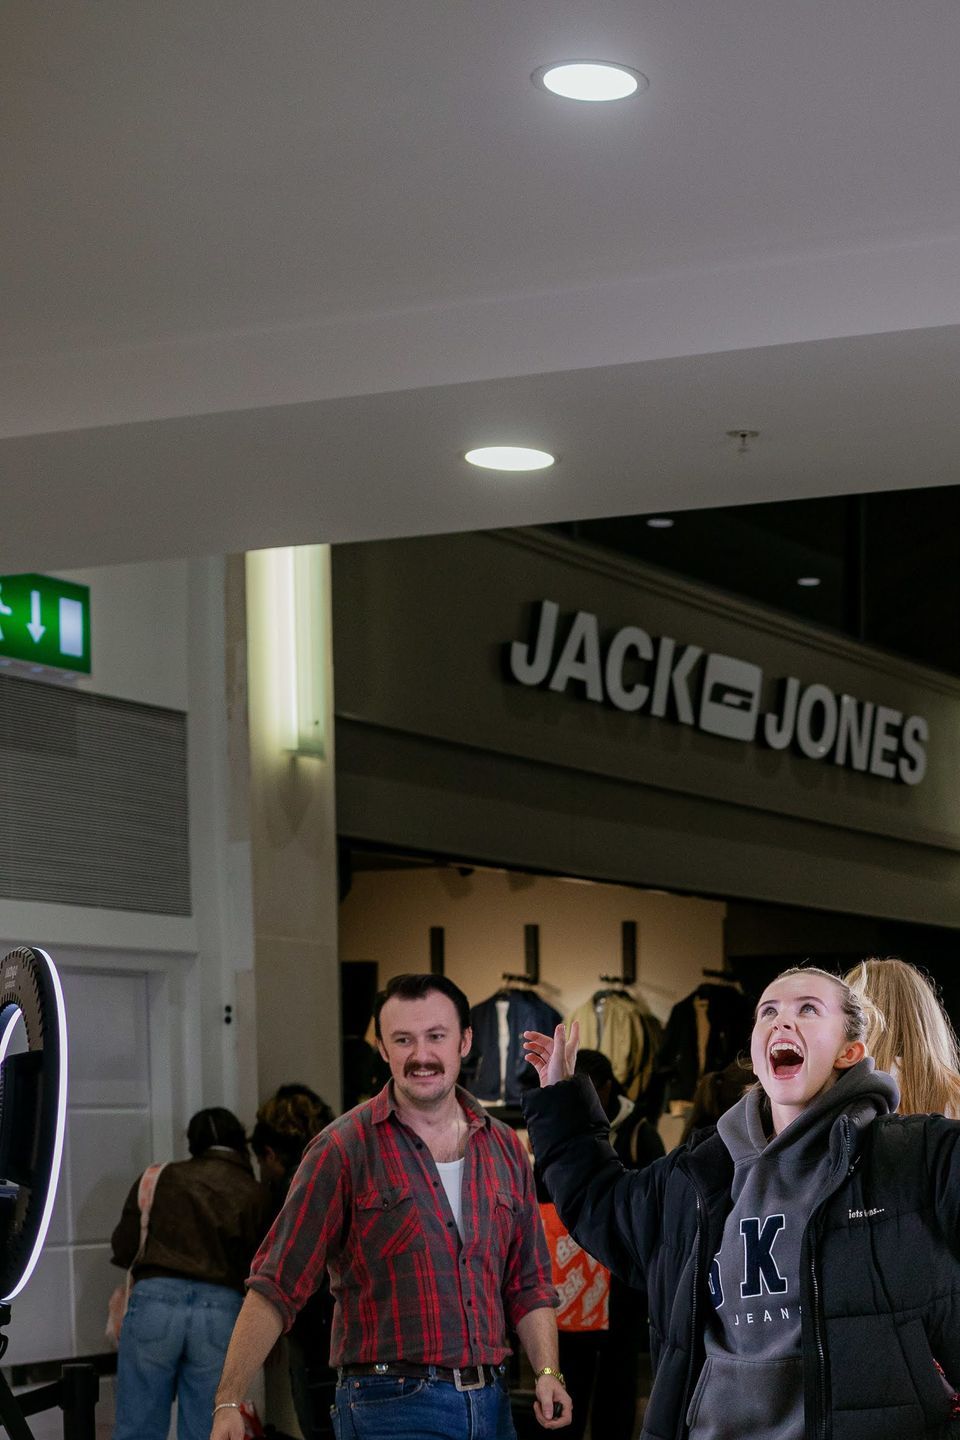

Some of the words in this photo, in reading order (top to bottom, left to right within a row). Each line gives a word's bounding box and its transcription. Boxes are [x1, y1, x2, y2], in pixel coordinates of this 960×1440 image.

[510, 600, 703, 726] JACK
[764, 677, 929, 785] JONES
[734, 1306, 802, 1326] JEAN
